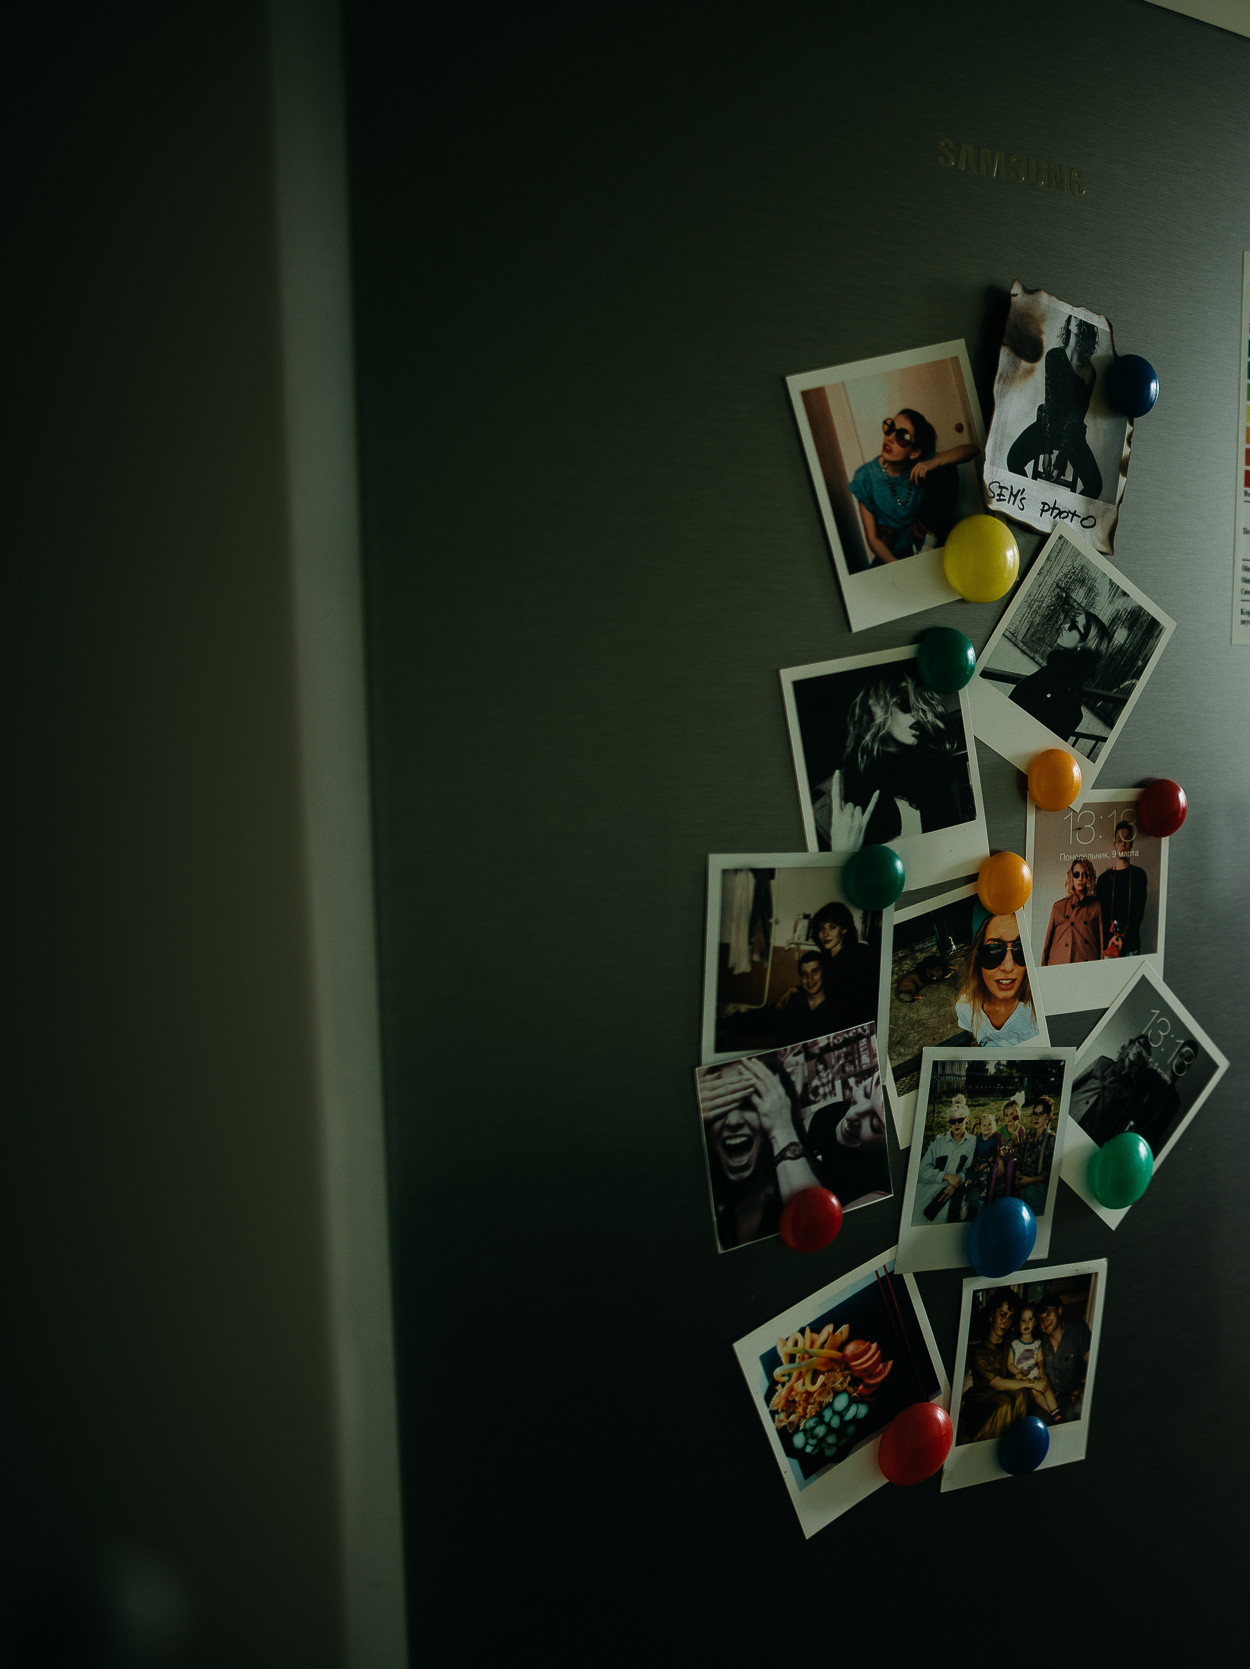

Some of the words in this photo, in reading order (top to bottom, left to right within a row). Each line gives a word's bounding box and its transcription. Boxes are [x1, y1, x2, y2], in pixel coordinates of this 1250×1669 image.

[937, 136, 1086, 196] SAMSUNG
[988, 481, 1027, 511] SEM's
[1040, 499, 1097, 529] photo
[1064, 809, 1138, 844] 13:13
[1059, 852, 1111, 862] Понедельник,
[1111, 850, 1117, 858] 9
[1118, 849, 1140, 859] марта
[1142, 1009, 1196, 1077] 13:13
